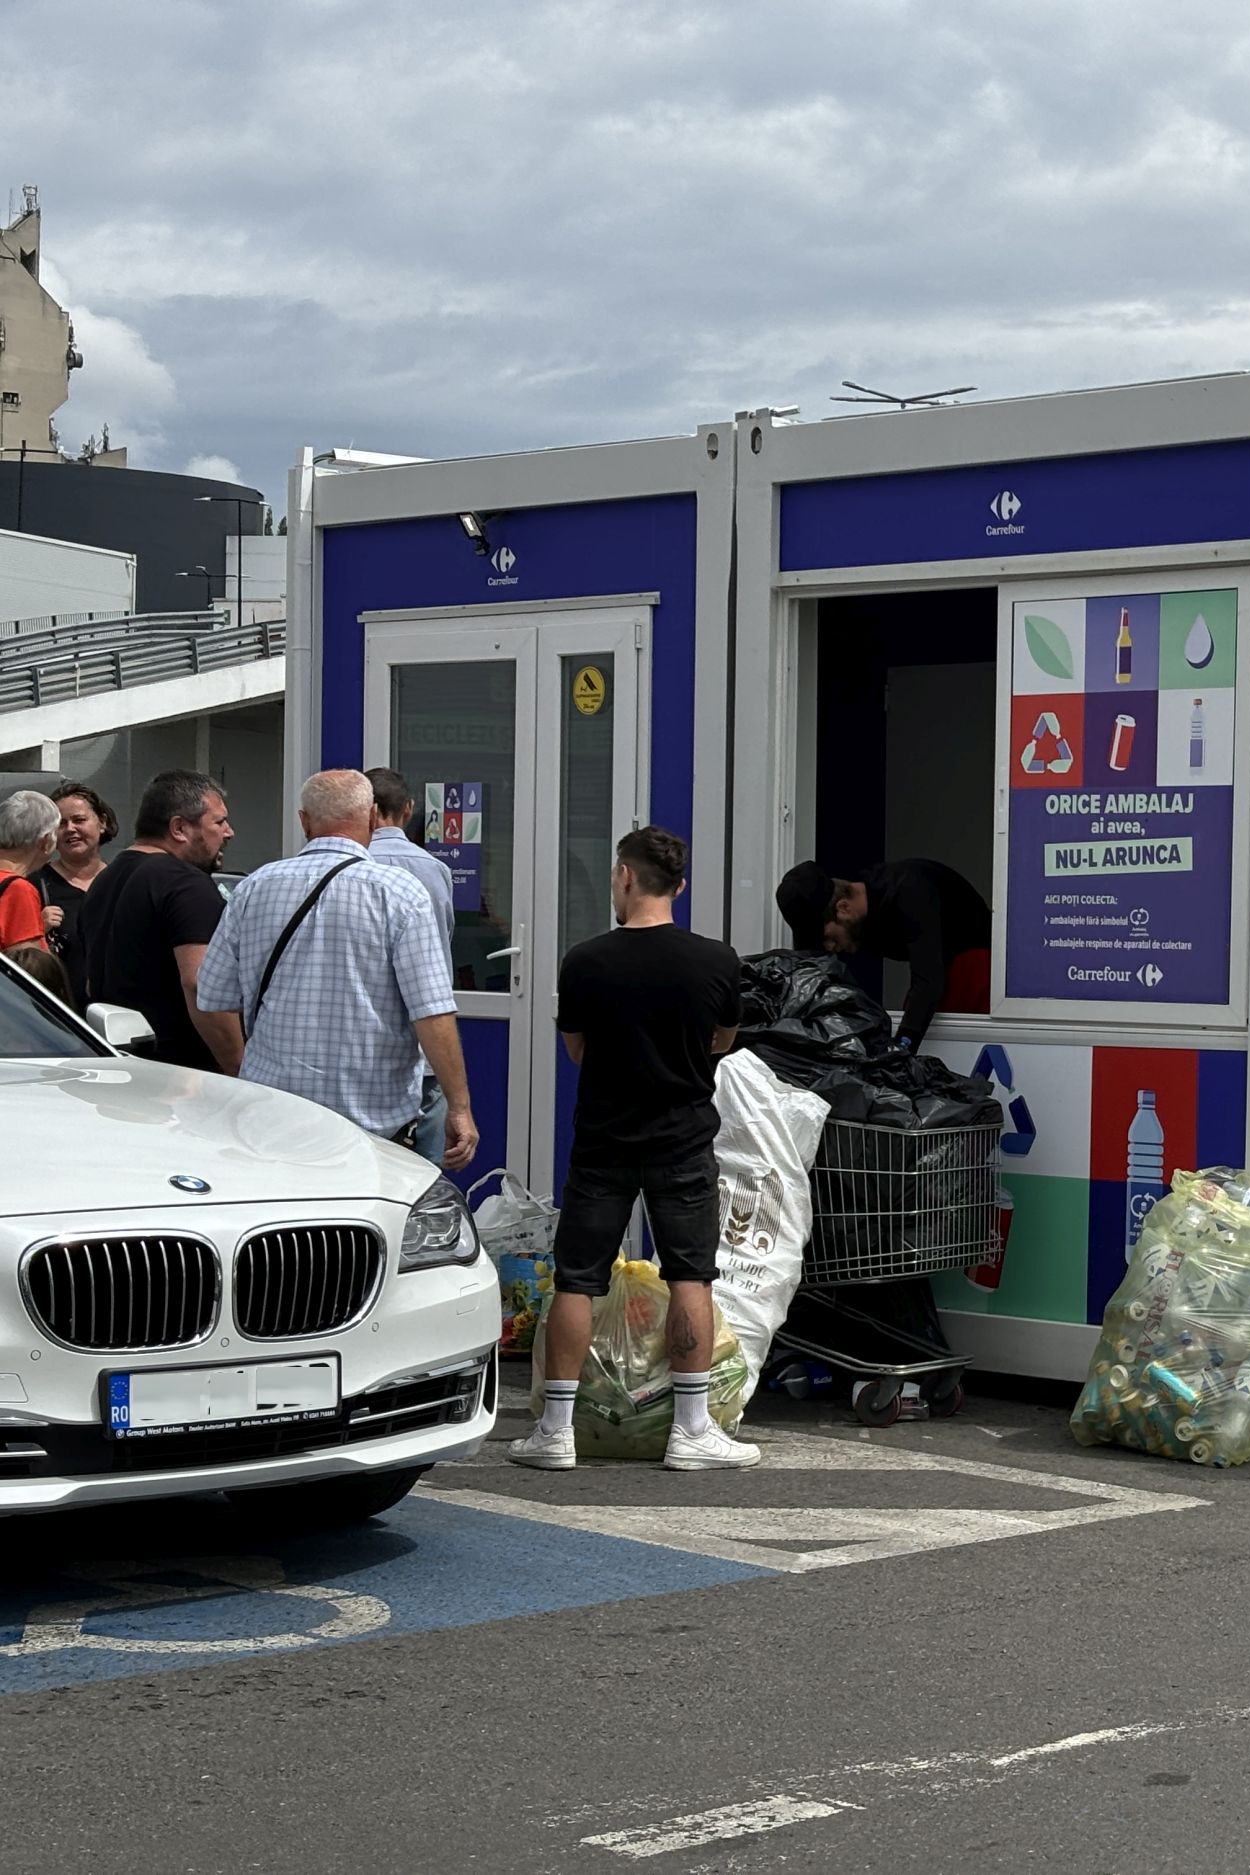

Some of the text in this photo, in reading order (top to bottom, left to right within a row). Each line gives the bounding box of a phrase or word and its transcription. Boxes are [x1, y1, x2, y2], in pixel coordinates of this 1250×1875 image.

[986, 523, 1025, 536] Carrefour
[487, 576, 519, 586] Carrefour
[1045, 792, 1194, 815] ORICE AMBALAJ
[1091, 817, 1146, 836] ai avea,
[1055, 844, 1182, 869] NU-L ARUNCA
[1044, 895, 1118, 907] AICI POȚI COLECTA:
[1050, 916, 1085, 927] ambalajele
[1101, 916, 1128, 926] simbolul
[1050, 938, 1192, 950] ambalajele respinse de aparatul de colectare
[1068, 965, 1131, 982] Carrefour
[111, 1405, 128, 1423] RO
[126, 1429, 146, 1437] Group
[147, 1427, 161, 1435] West
[162, 1426, 184, 1434] Motors
